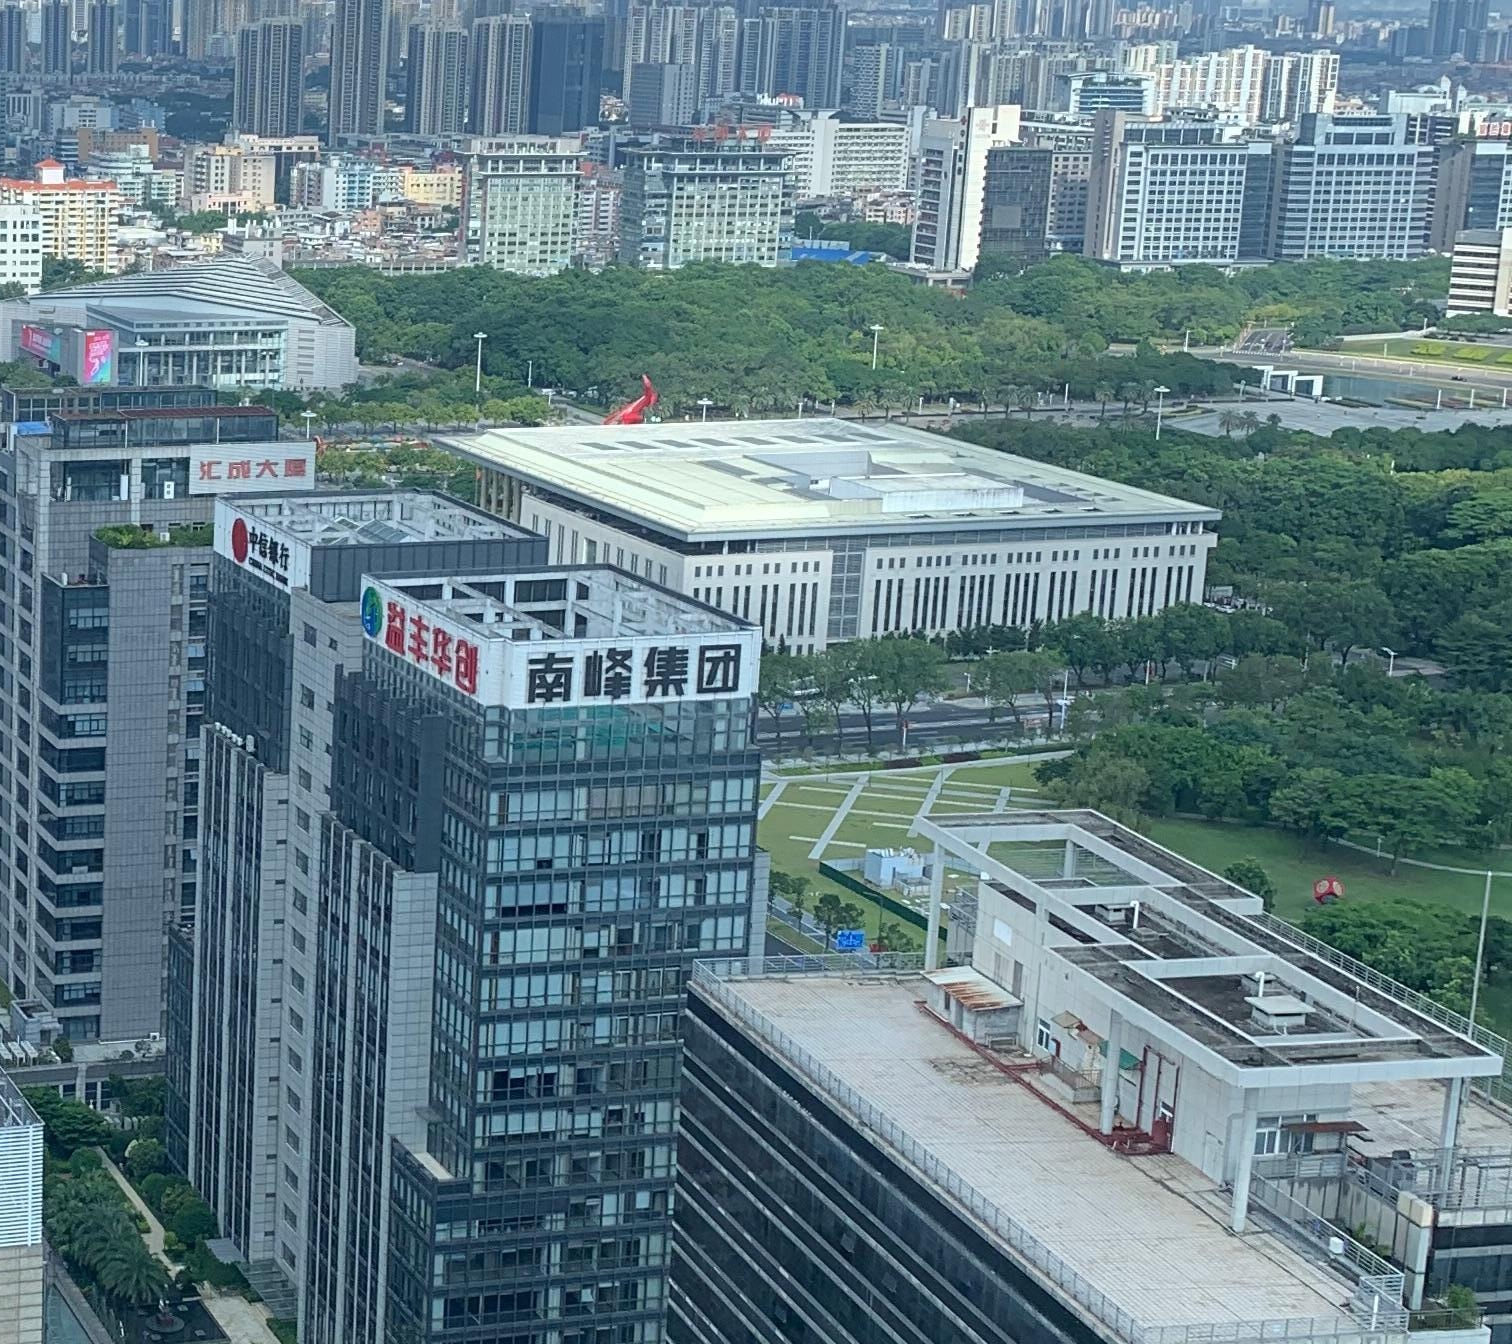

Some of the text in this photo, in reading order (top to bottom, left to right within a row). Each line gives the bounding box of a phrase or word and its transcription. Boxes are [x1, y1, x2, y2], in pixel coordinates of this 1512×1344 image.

[199, 458, 307, 480] 汇成大厦
[385, 601, 478, 695] 益丰华创
[527, 643, 742, 704] 南峰集团
